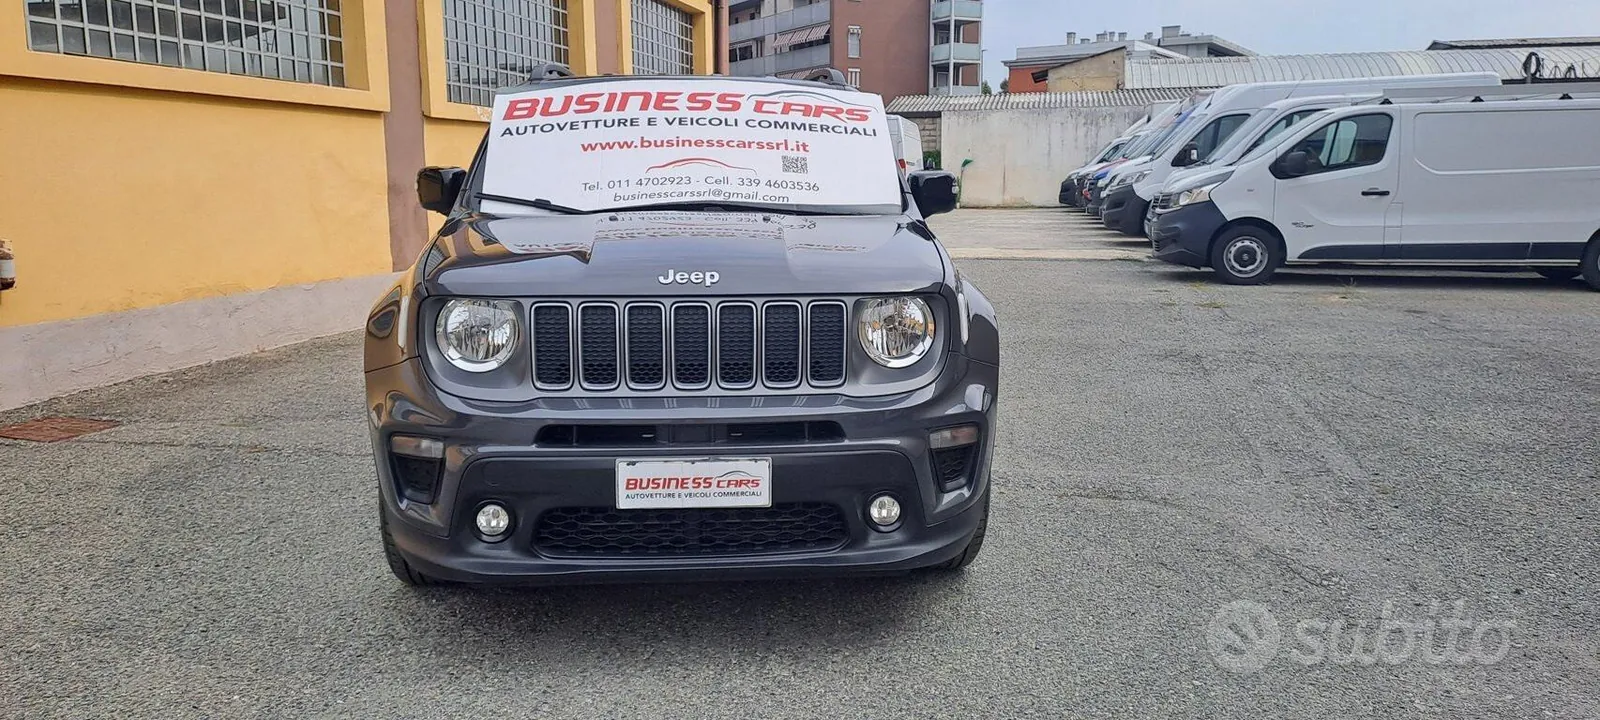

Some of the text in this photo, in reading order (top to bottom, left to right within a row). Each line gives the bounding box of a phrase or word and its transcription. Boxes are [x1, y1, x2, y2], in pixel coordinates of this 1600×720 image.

[502, 91, 872, 123] BUSINESS CARS
[500, 116, 877, 137] AUTOVETTURE E VEICOLI COMMERCIALI
[580, 136, 810, 153] www.businesscarssrl.it
[582, 182, 603, 192] Tel.
[607, 179, 630, 189] 011
[635, 176, 692, 188] 4702923
[704, 175, 733, 186] Cell.
[737, 176, 760, 187] 339
[765, 179, 820, 192] 4603536
[613, 187, 790, 203] businesscarssrl@gmail.com
[658, 268, 720, 286] Jeep
[625, 476, 762, 491] BUSINESS CARS
[684, 491, 711, 499] VEICOLI
[713, 490, 762, 498] COMMERCIALI
